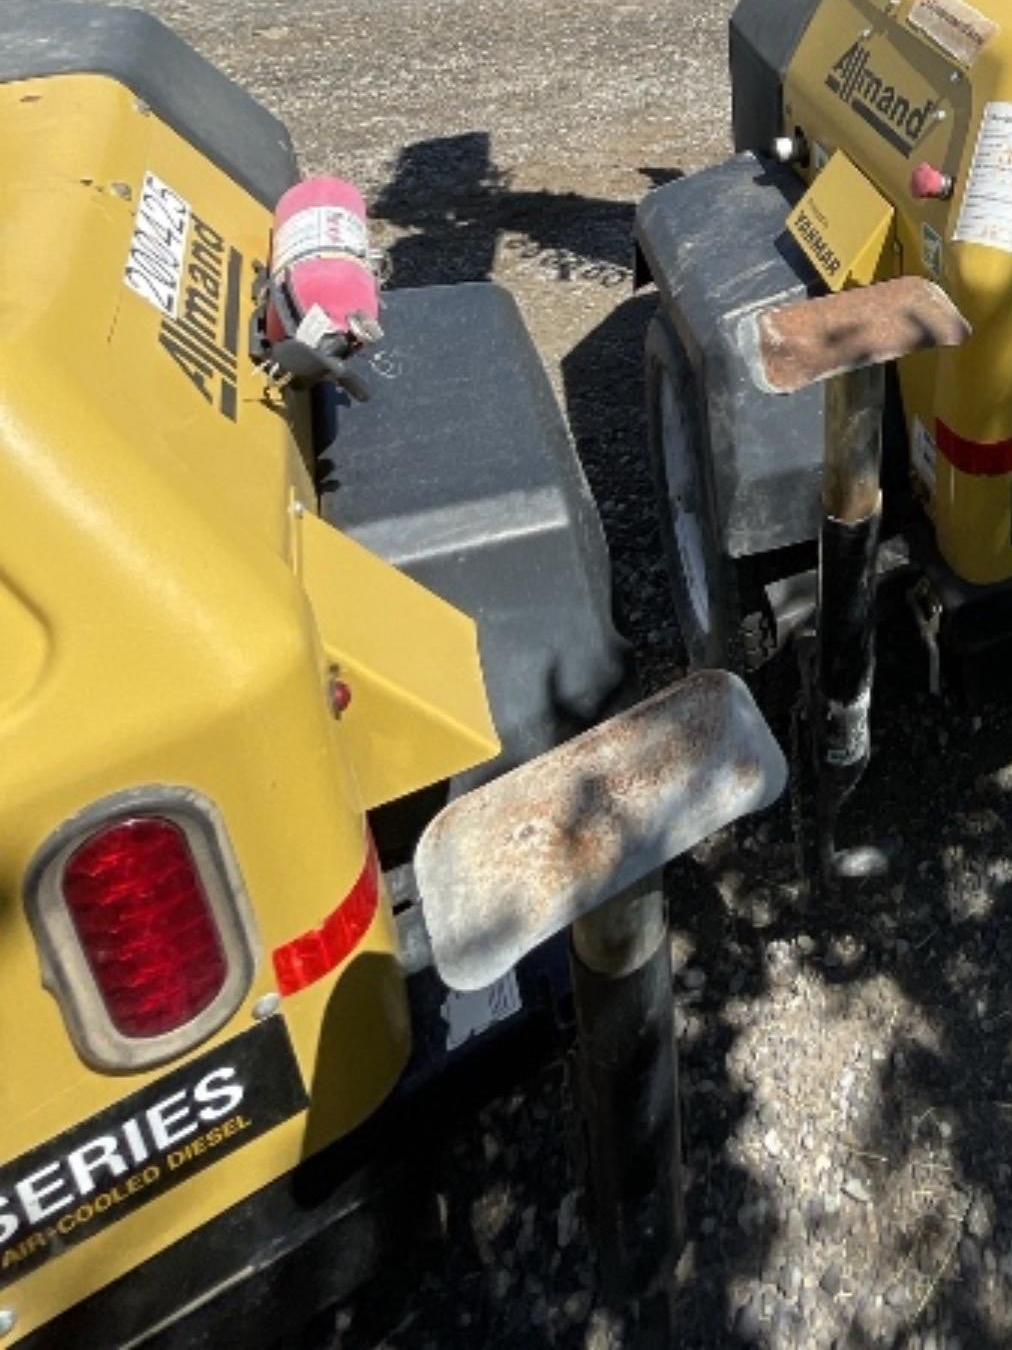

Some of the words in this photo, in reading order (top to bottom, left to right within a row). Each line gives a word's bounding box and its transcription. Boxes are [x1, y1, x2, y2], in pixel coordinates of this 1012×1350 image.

[832, 41, 934, 139] Allmand
[158, 212, 238, 406] Allmand
[2, 1165, 161, 1268] AIR-COOLED
[167, 1114, 253, 1170] DIESEL
